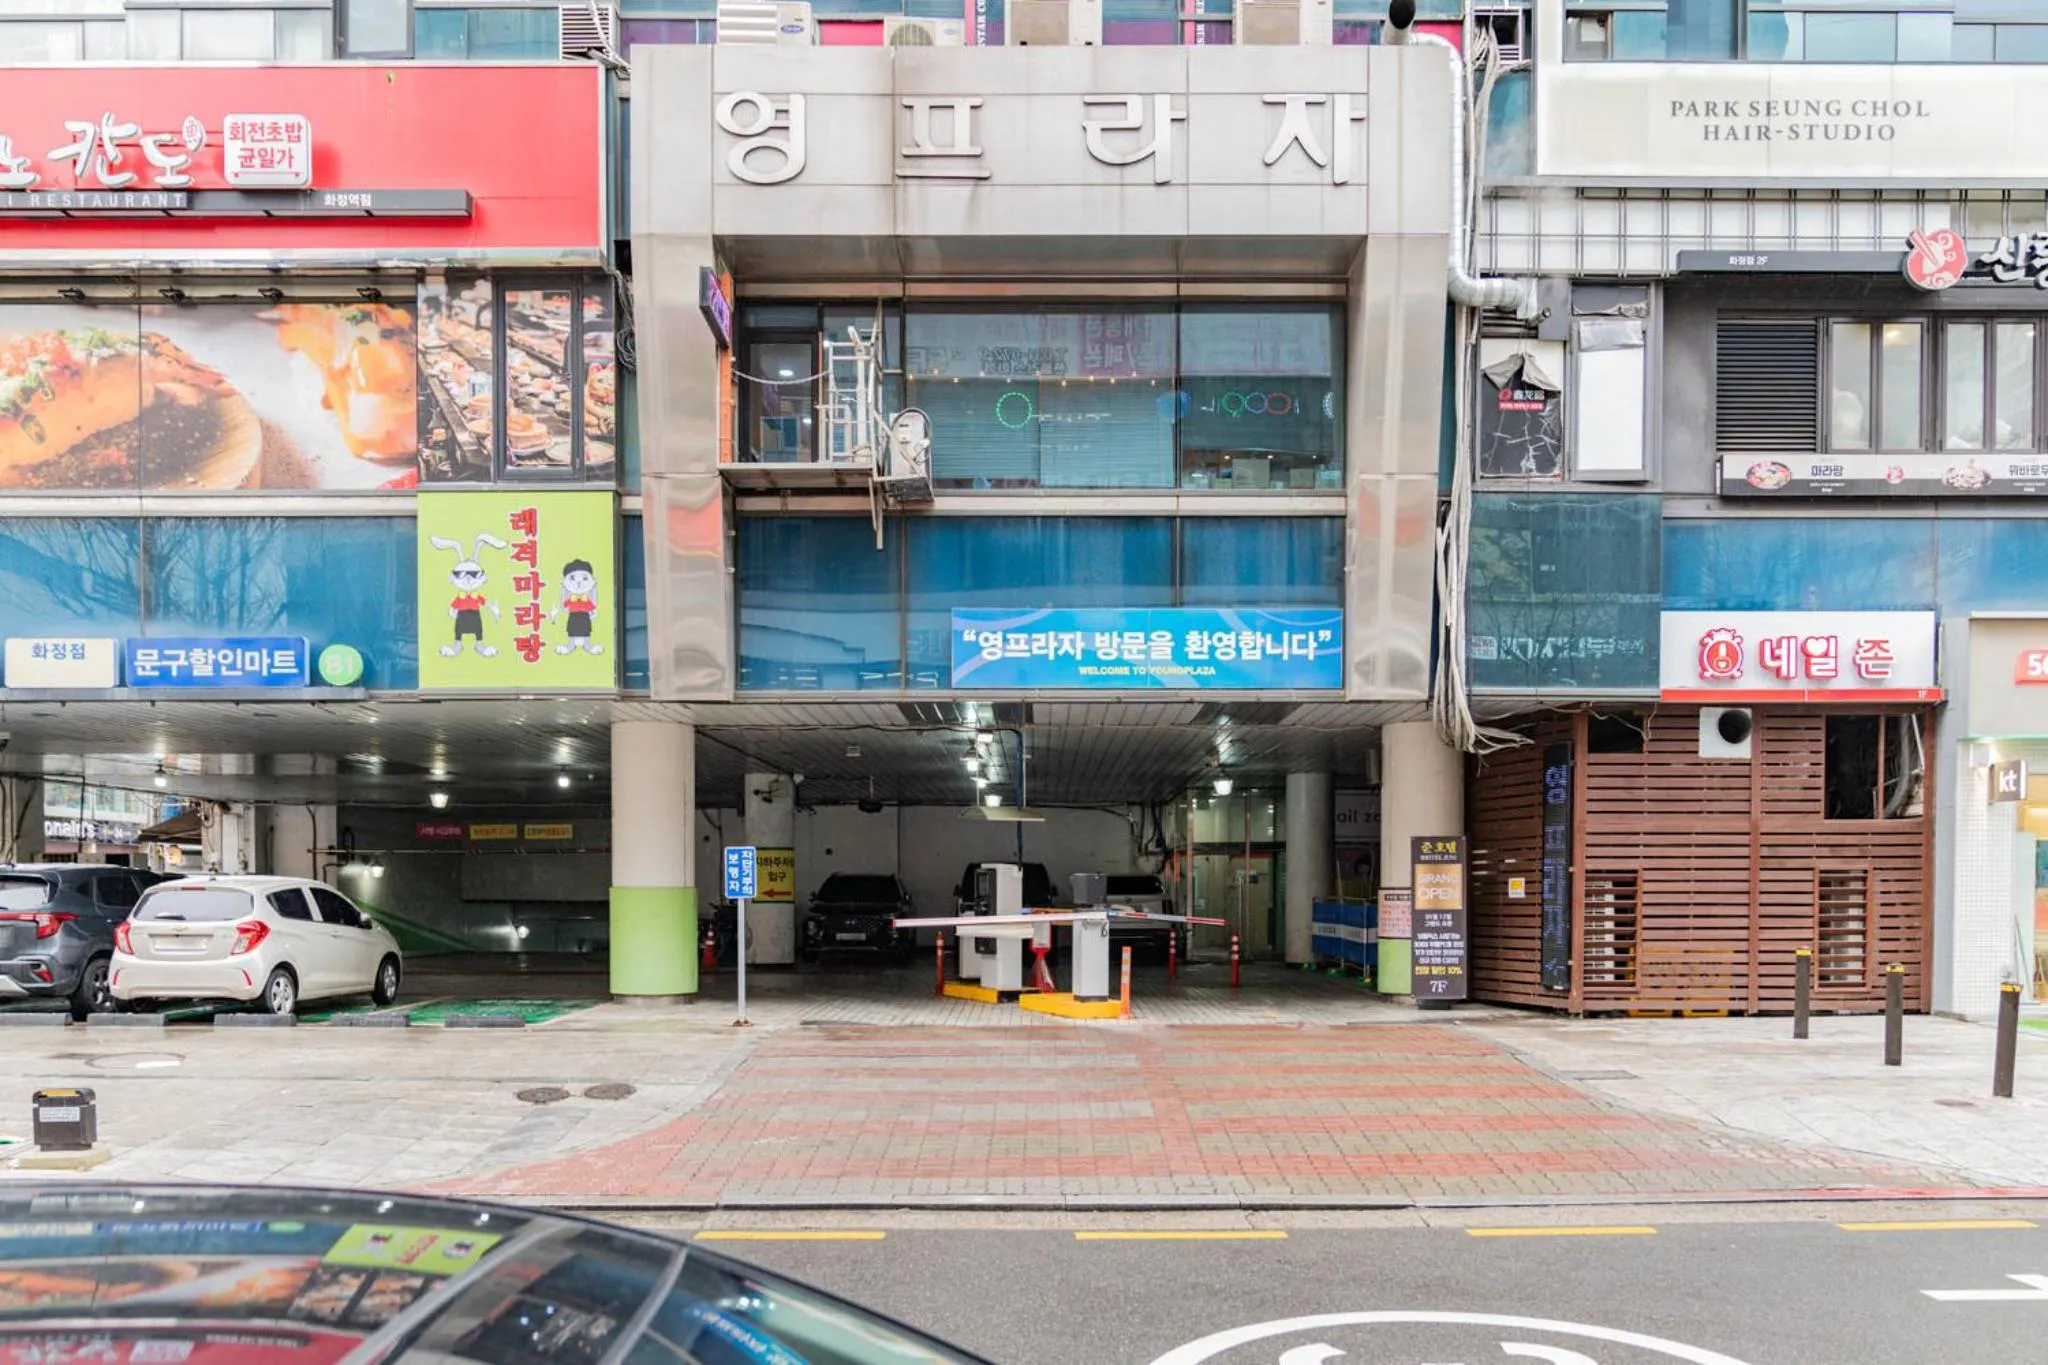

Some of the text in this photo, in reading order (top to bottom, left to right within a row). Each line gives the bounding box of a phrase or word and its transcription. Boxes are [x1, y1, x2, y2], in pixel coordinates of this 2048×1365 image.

[1671, 100, 1931, 118] PARK SEUNG CHOL
[229, 121, 304, 143] 회전초밥
[715, 91, 1366, 185] 영프라자
[1703, 124, 1896, 142] HAIR-STUDIO
[237, 147, 295, 169] 균일가
[30, 193, 185, 208] RESTAURANT
[323, 193, 372, 208] 화정역점
[32, 642, 87, 661] 화정점
[1094, 630, 1174, 661] 방문을
[134, 647, 300, 678] 문구할인마트
[1758, 635, 1896, 680] 네일 존
[1078, 665, 1217, 676] WELCOME TO YOUNGPLAZA
[1998, 769, 2018, 793] kt
[728, 853, 740, 892] 보행자
[1430, 980, 1448, 993] 7F
